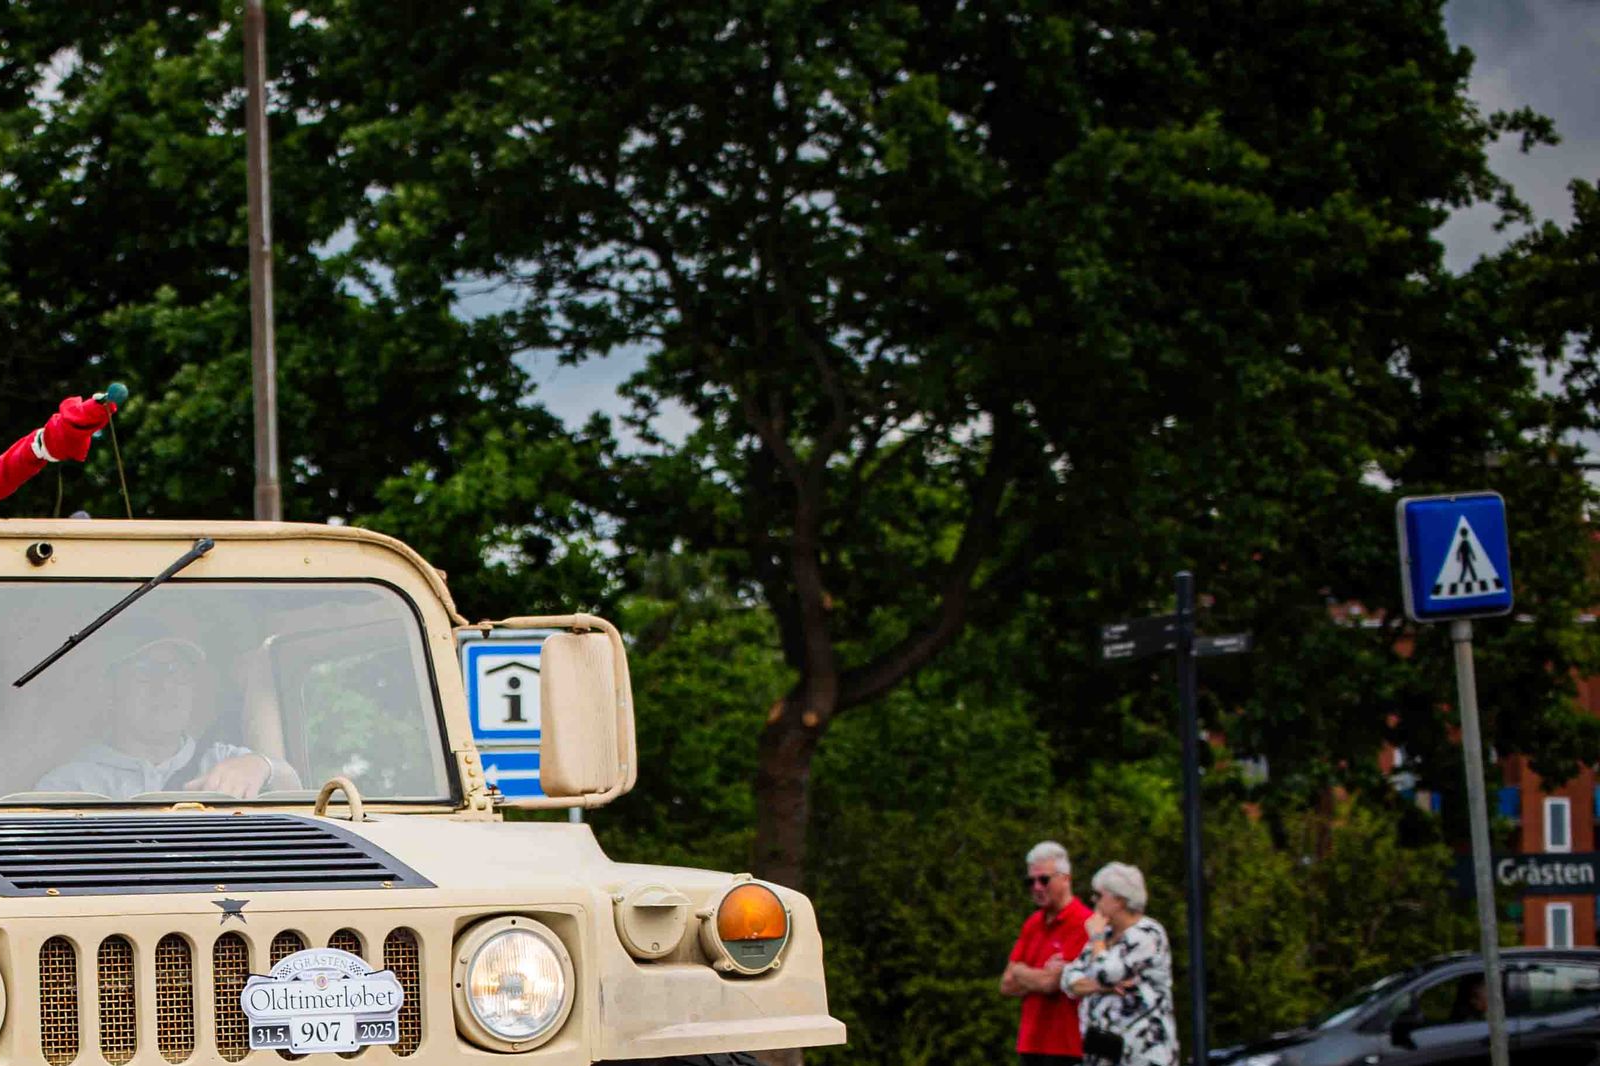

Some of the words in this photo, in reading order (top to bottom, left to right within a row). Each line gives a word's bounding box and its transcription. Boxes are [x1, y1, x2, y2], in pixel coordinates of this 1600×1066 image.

[1497, 857, 1595, 886] Gråsten
[250, 986, 395, 1011] Oldtimerløbet
[257, 1028, 289, 1044] 31.5.
[301, 1022, 341, 1043] 907
[360, 1024, 392, 1039] 2025
